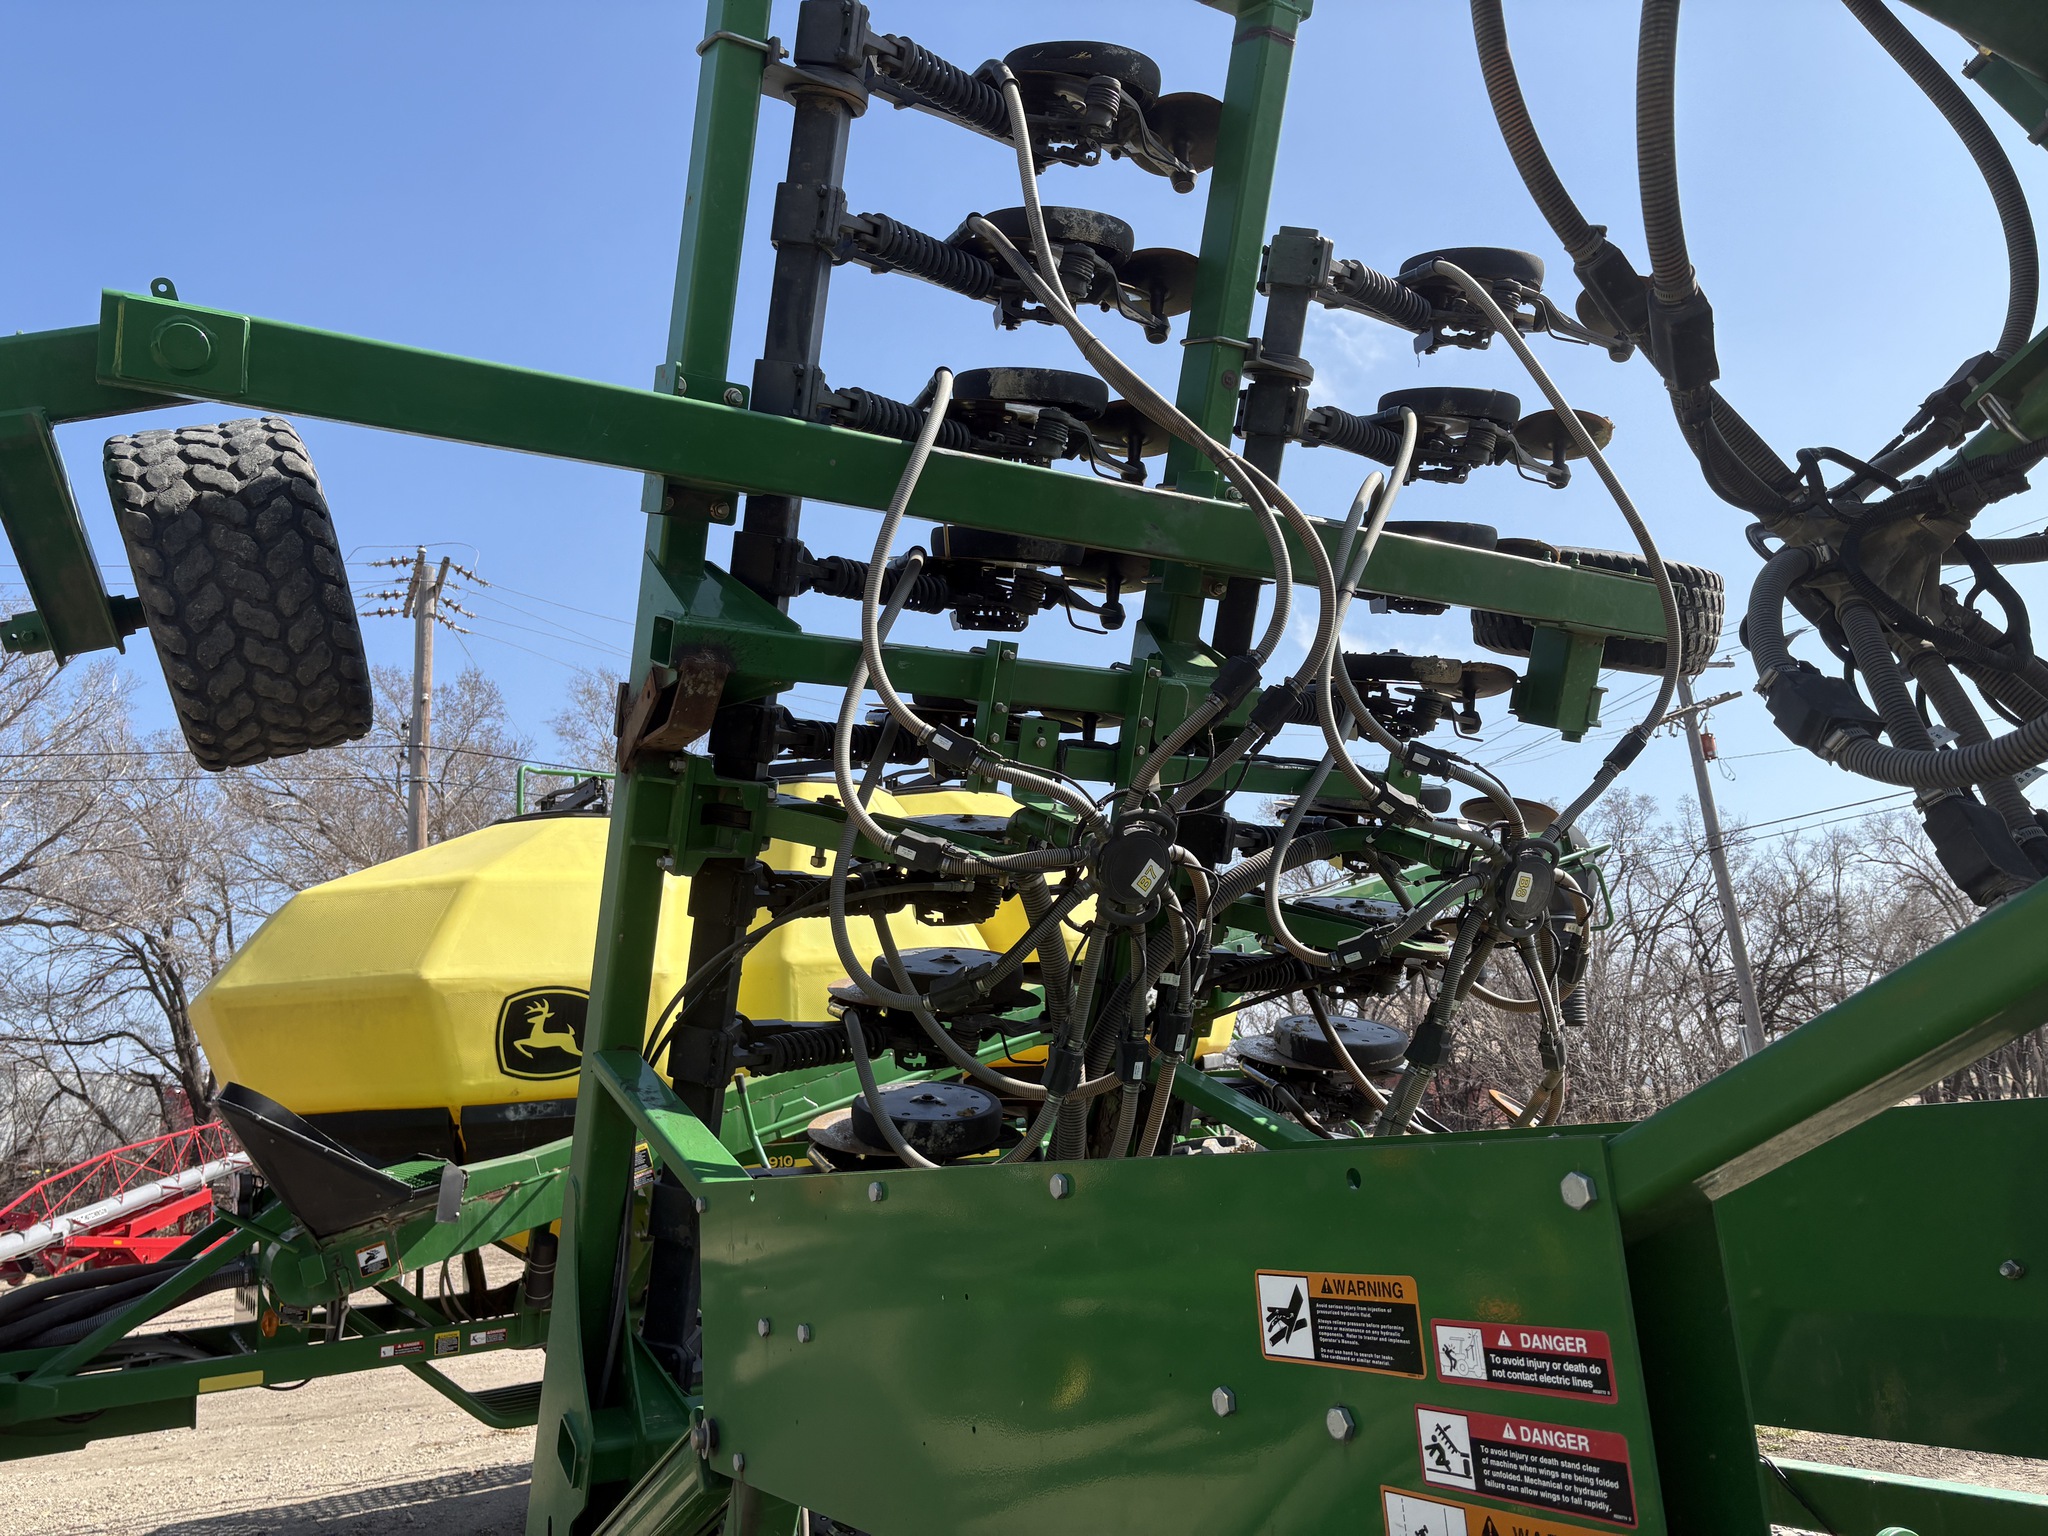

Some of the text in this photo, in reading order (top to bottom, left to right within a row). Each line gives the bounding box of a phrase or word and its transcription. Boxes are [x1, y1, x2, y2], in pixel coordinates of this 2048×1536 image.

[1137, 865, 1156, 892] B7
[1516, 876, 1531, 897] B8
[1333, 1279, 1403, 1298] WARNING
[1520, 1333, 1588, 1353] DANGER
[1372, 1358, 1391, 1366] material.
[1489, 1354, 1601, 1375] To avoid injury or death do
[1492, 1369, 1593, 1388] not contact electric lines
[1520, 1426, 1590, 1452] DANGER
[1480, 1445, 1489, 1453] To
[1490, 1447, 1508, 1456] avoid
[1509, 1449, 1529, 1461] injury
[1539, 1455, 1559, 1466] death
[1561, 1459, 1580, 1470] stand
[1582, 1463, 1600, 1474] clear
[1490, 1458, 1517, 1470] machine
[1519, 1463, 1537, 1474] when
[1538, 1467, 1559, 1478] wings
[1561, 1472, 1572, 1480] are
[1574, 1473, 1594, 1486] being
[1595, 1477, 1619, 1489] folded
[1492, 1470, 1522, 1483] unfolded.
[1524, 1476, 1562, 1490] Mechanical
[1573, 1483, 1607, 1499] hydraulic
[1484, 1479, 1612, 1513] failure can allow wings to fall rapidly.
